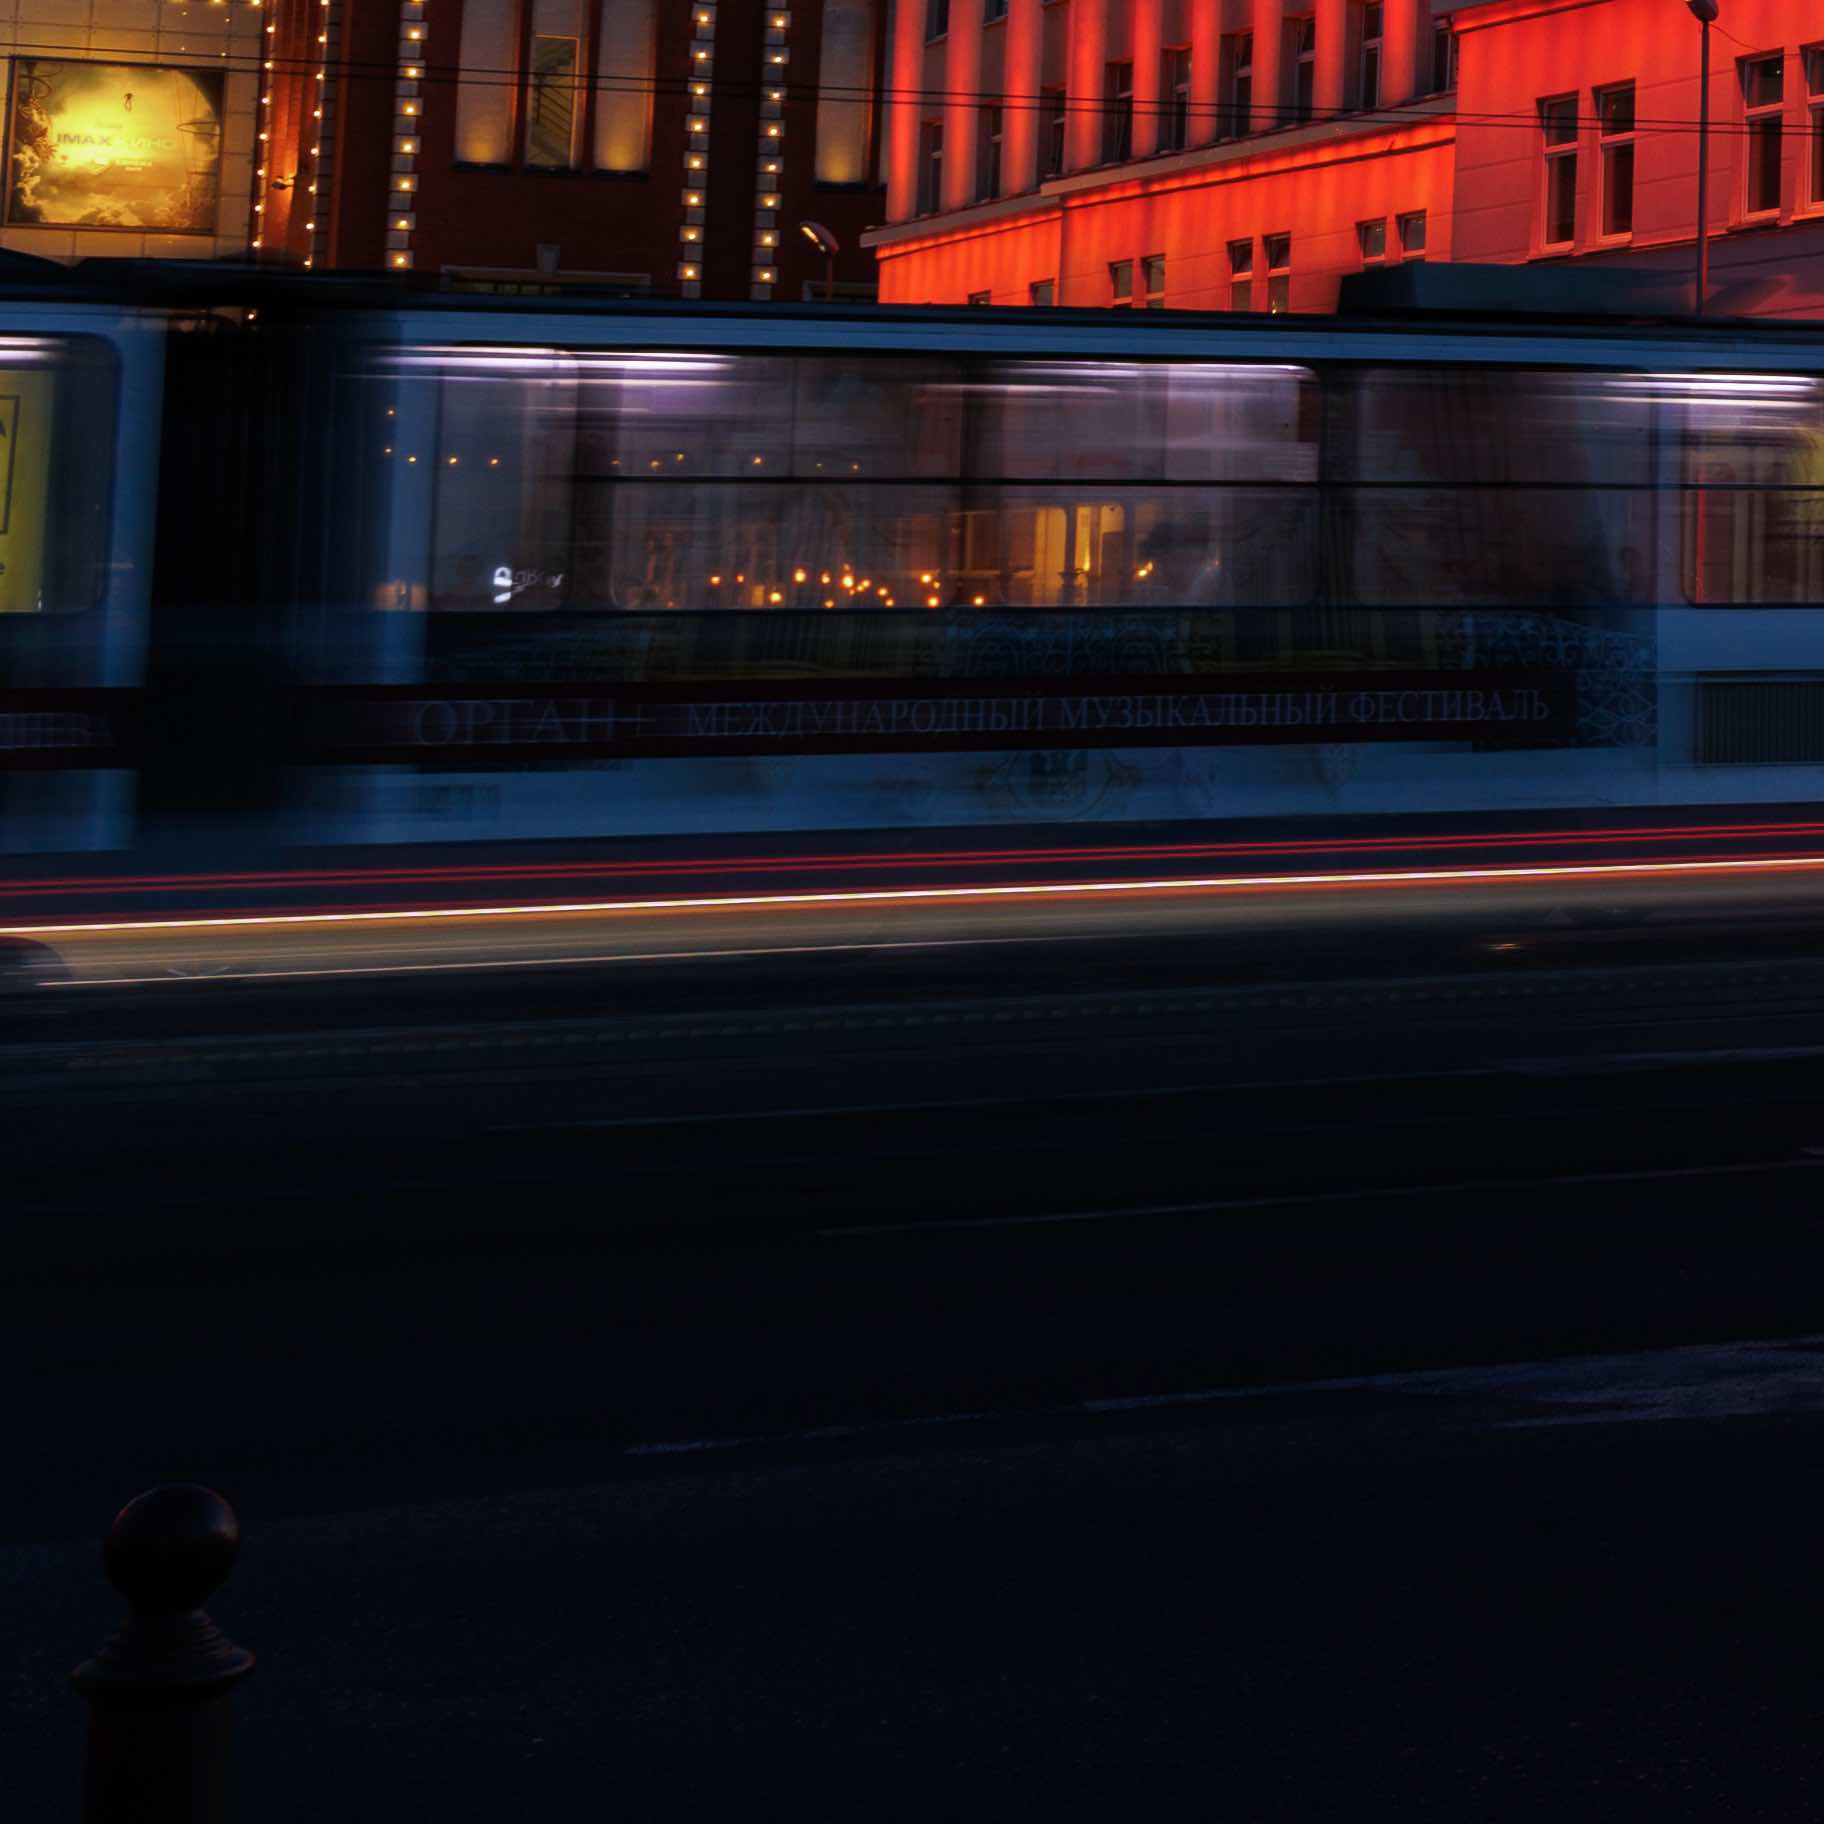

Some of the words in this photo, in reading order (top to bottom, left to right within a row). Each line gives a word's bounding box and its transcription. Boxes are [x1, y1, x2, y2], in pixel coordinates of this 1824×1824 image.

[57, 133, 111, 146] IMAX
[687, 690, 1045, 740] МЕЖДУНАРОДНЫЙ
[1059, 683, 1338, 729] МУЗЫКАЛЬНЫЙ
[1349, 687, 1553, 723] ФЕСТИВАЛЬ
